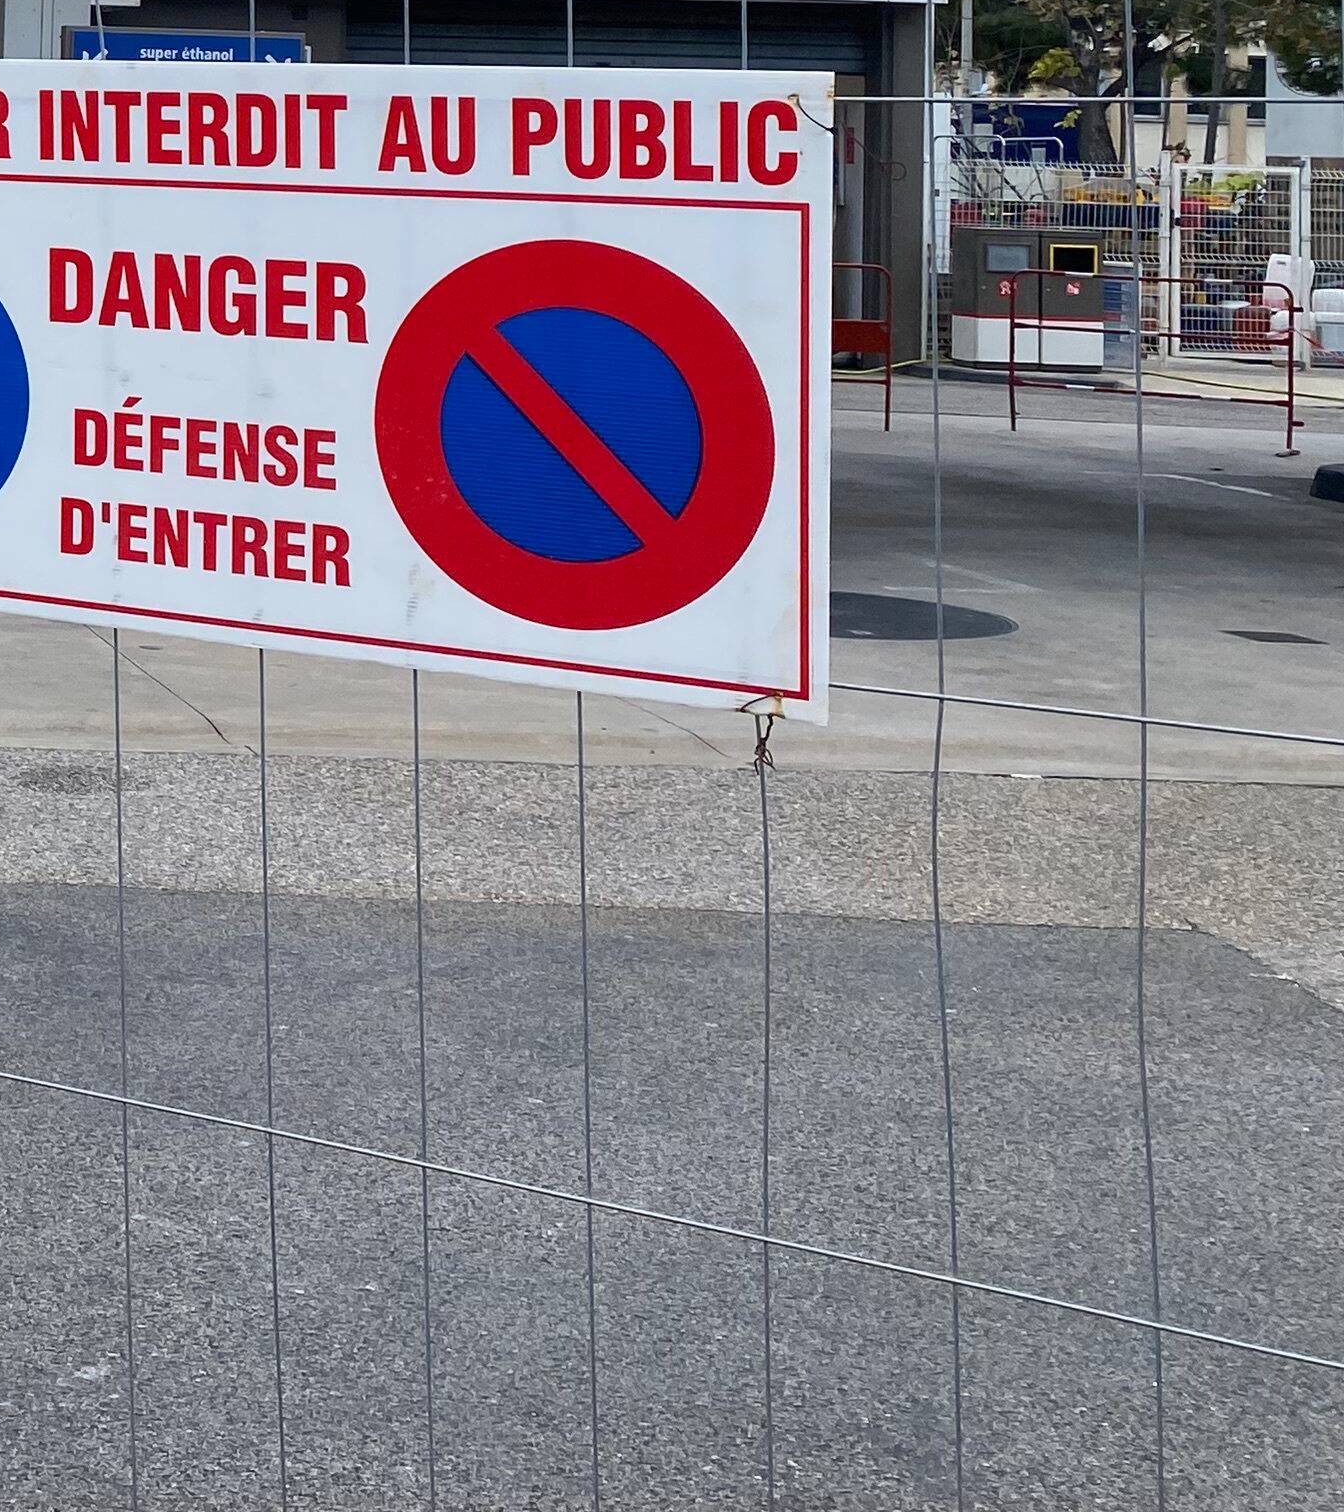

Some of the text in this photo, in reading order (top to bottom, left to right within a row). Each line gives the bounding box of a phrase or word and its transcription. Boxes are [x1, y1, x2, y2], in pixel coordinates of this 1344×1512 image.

[140, 46, 234, 62] super éthanol
[39, 89, 348, 171] INTERDIT
[377, 94, 476, 176] AU
[511, 96, 799, 186] PUBLIC
[48, 246, 370, 345] DANGER
[74, 395, 338, 492] DÉFENSE
[59, 495, 352, 588] D'ENTRER
